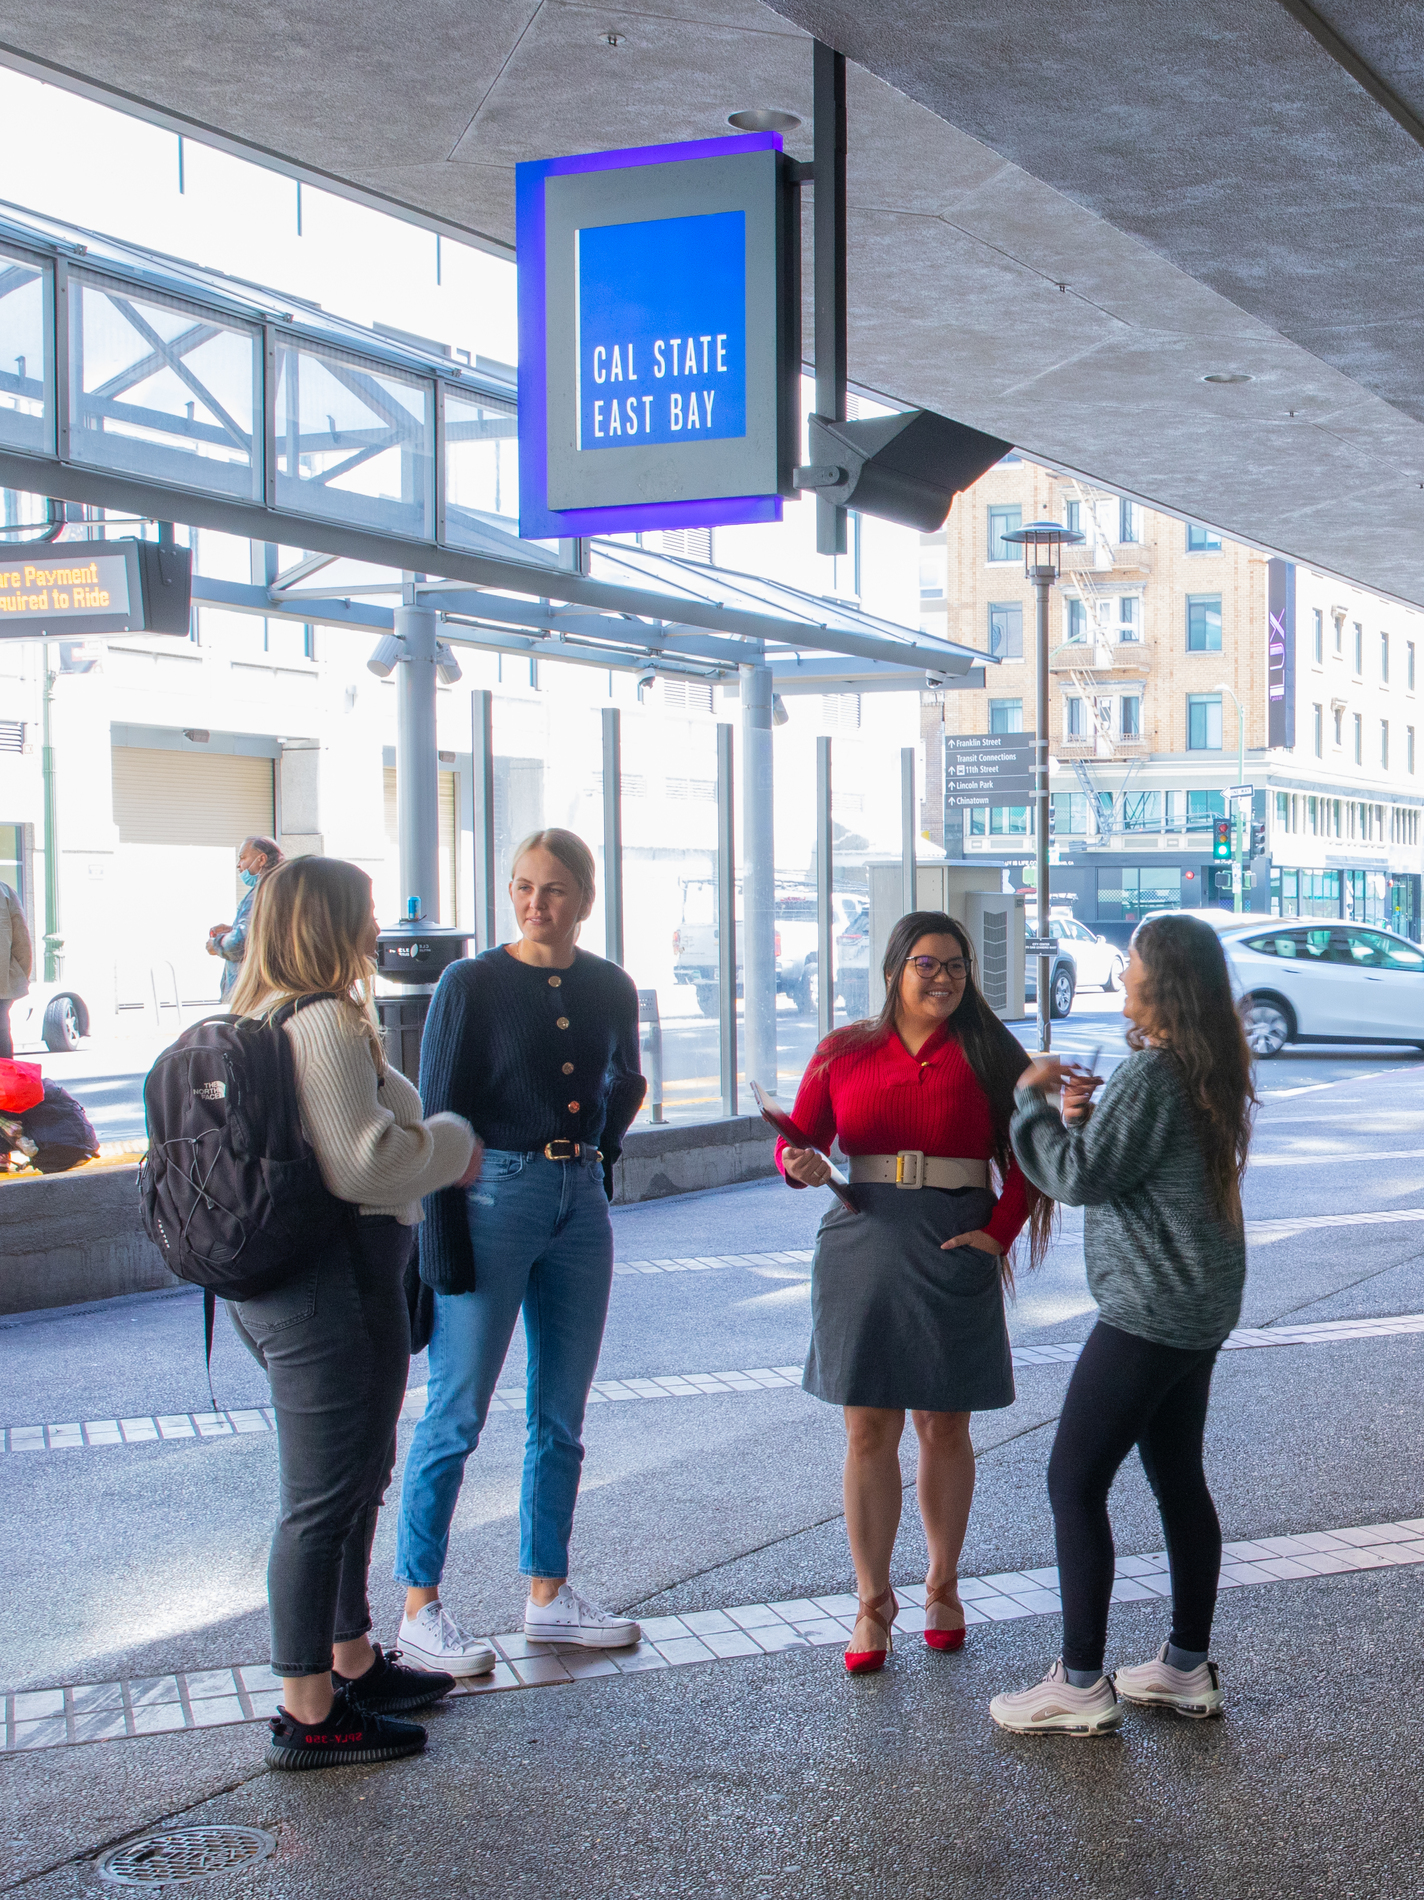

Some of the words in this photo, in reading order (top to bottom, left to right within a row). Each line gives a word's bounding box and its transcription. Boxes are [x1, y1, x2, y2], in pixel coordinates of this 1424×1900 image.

[593, 343, 638, 384] CAL
[653, 334, 728, 379] STATE
[593, 396, 654, 438] EAST
[670, 390, 716, 432] BAY
[0, 572, 21, 588] re
[24, 562, 99, 587] Payment
[52, 588, 70, 609] to
[73, 586, 110, 608] Ride
[1270, 608, 1285, 697] LUX
[956, 739, 980, 748] Franklin
[982, 738, 1001, 746] Street
[956, 754, 978, 763] Transit
[978, 753, 1017, 762] Connections
[965, 765, 978, 774] 11th
[979, 765, 999, 773] Street
[956, 781, 978, 790] Lincoln
[979, 781, 994, 789] Park
[956, 797, 989, 805] Chinatown
[203, 1081, 218, 1089] THE
